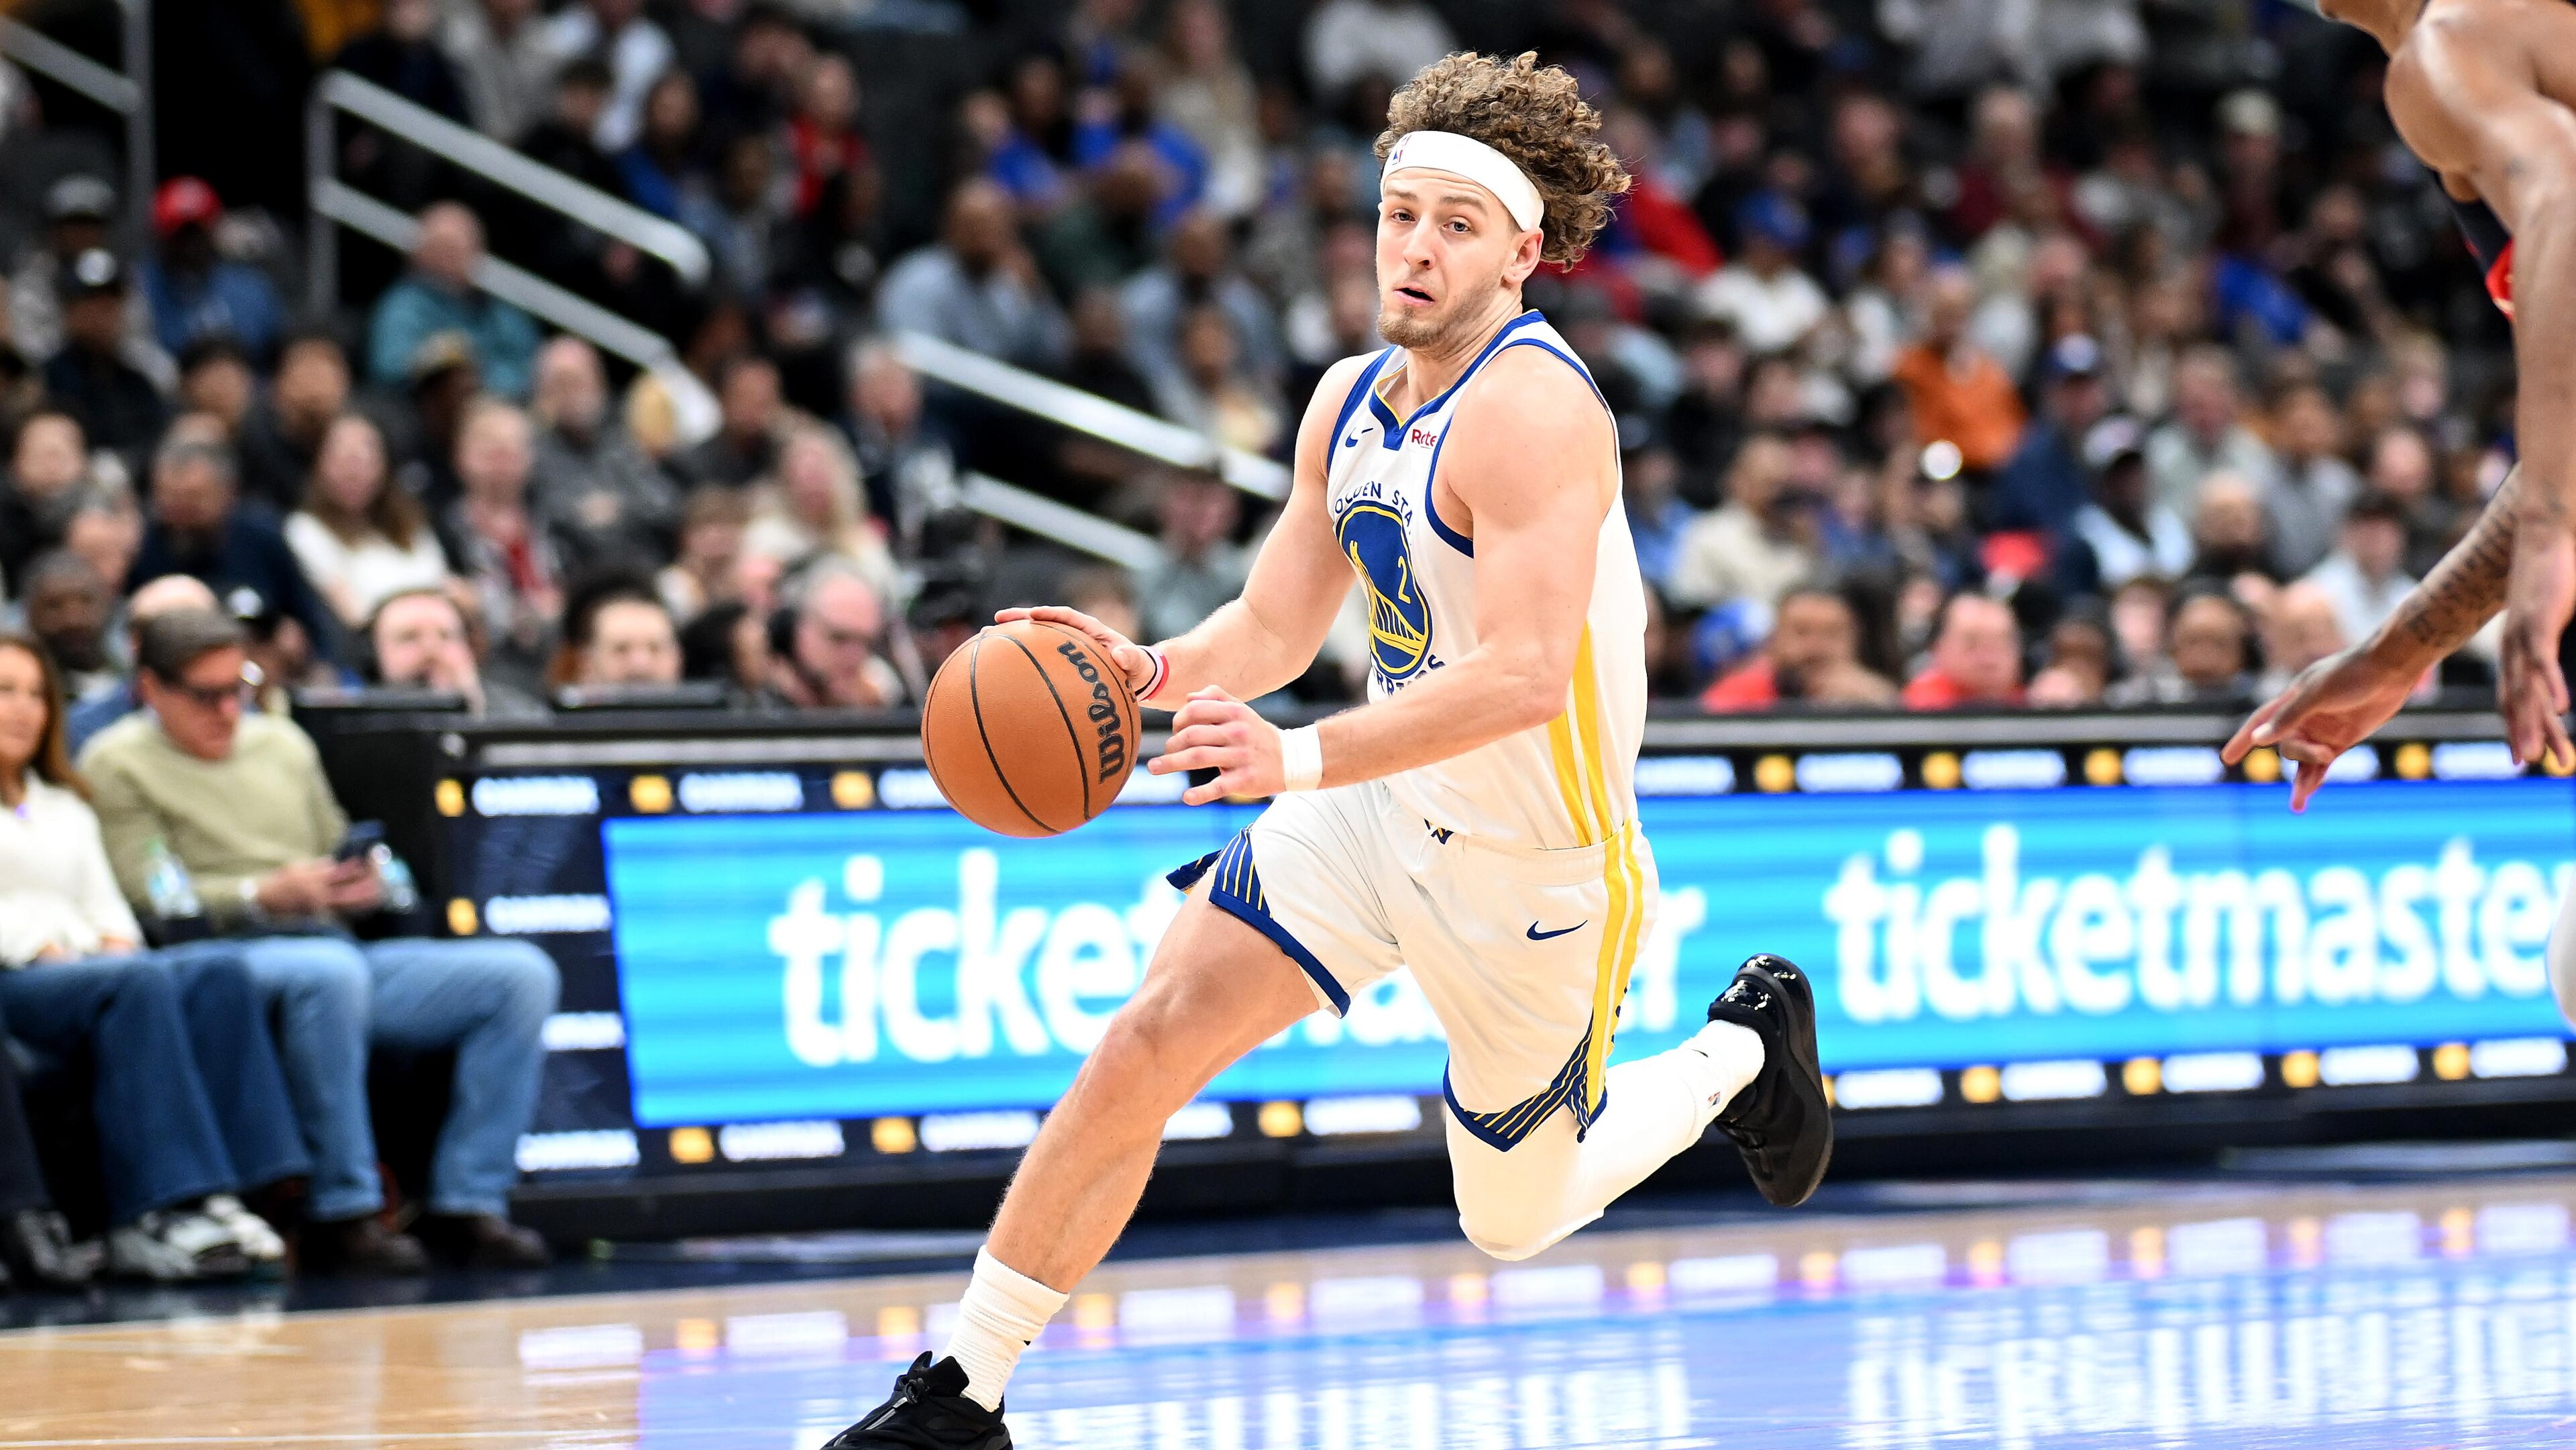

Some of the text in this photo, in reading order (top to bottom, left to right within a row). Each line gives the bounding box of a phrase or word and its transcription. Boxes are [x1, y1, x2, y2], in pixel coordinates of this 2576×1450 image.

[1392, 490, 1412, 546] STA
[1398, 556, 1411, 604] 2
[1057, 641, 1125, 784] Wilson
[1821, 823, 2575, 1021] ticketmaste
